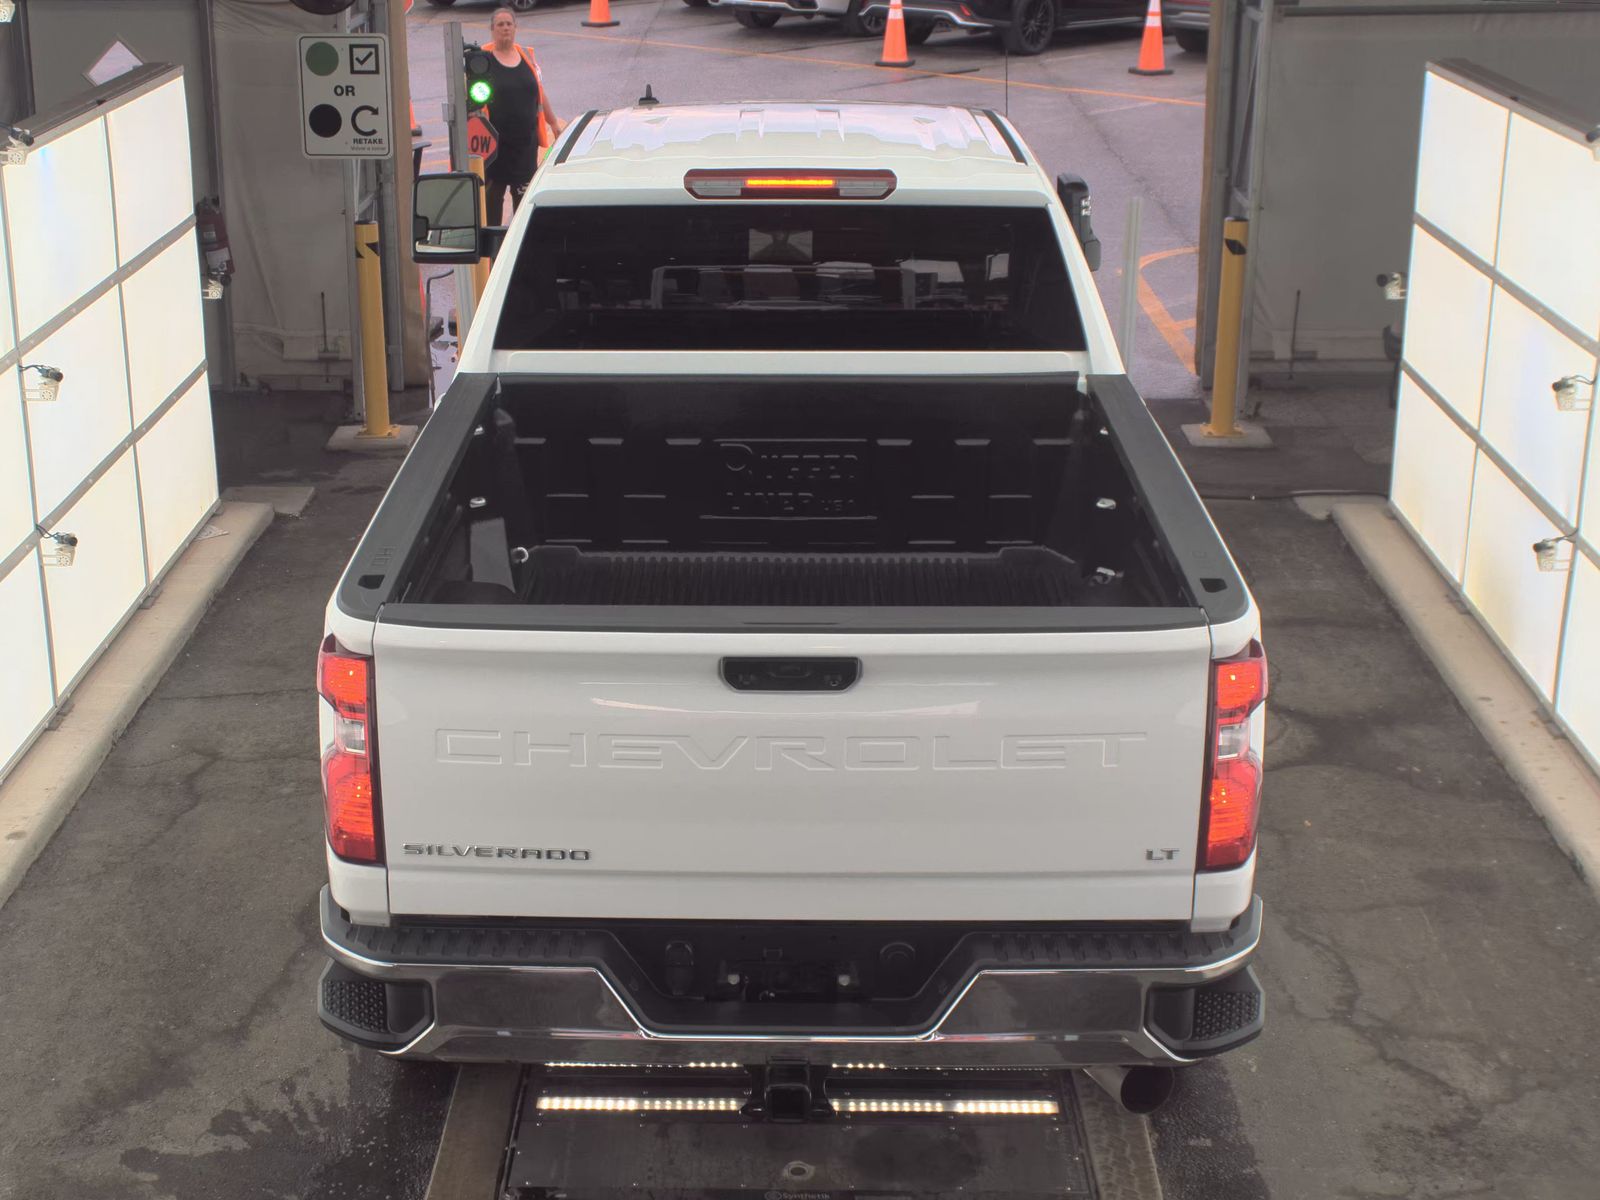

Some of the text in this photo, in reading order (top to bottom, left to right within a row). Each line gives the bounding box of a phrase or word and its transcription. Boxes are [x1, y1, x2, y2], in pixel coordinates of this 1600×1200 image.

[334, 85, 355, 97] OR
[471, 135, 491, 153] OW
[435, 728, 1148, 771] CHEVROLET
[402, 843, 590, 861] SILVERADO
[1146, 848, 1180, 861] LT
